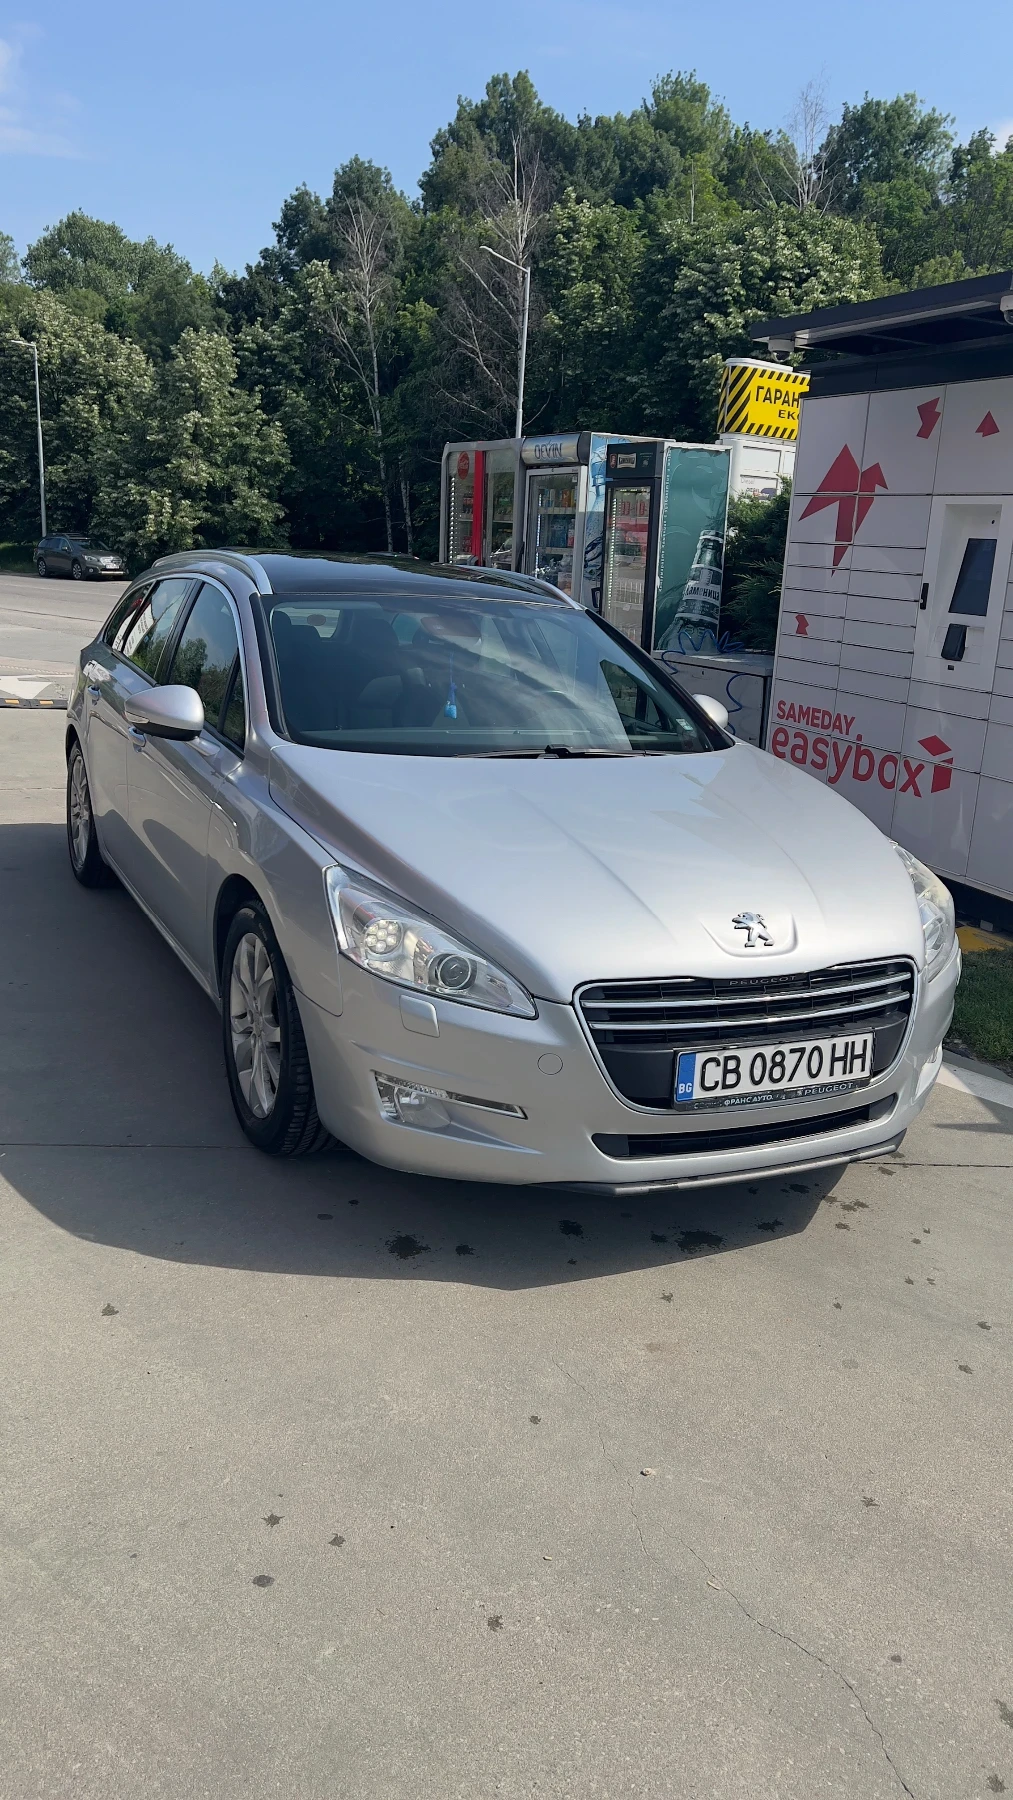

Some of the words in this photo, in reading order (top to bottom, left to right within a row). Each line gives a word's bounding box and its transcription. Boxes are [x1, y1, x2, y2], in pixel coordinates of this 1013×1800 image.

[755, 385, 800, 408] ГАРАН
[778, 409, 800, 421] ЕК
[534, 441, 563, 460] DEVIN
[776, 699, 856, 736] SAMEDAY
[771, 727, 925, 798] easybox
[729, 975, 797, 986] PEUGEOT
[700, 1055, 741, 1092] CB
[750, 1045, 823, 1086] 0870
[829, 1039, 868, 1077] HH
[678, 1083, 693, 1094] BG
[804, 1083, 853, 1096] PEUGEOT
